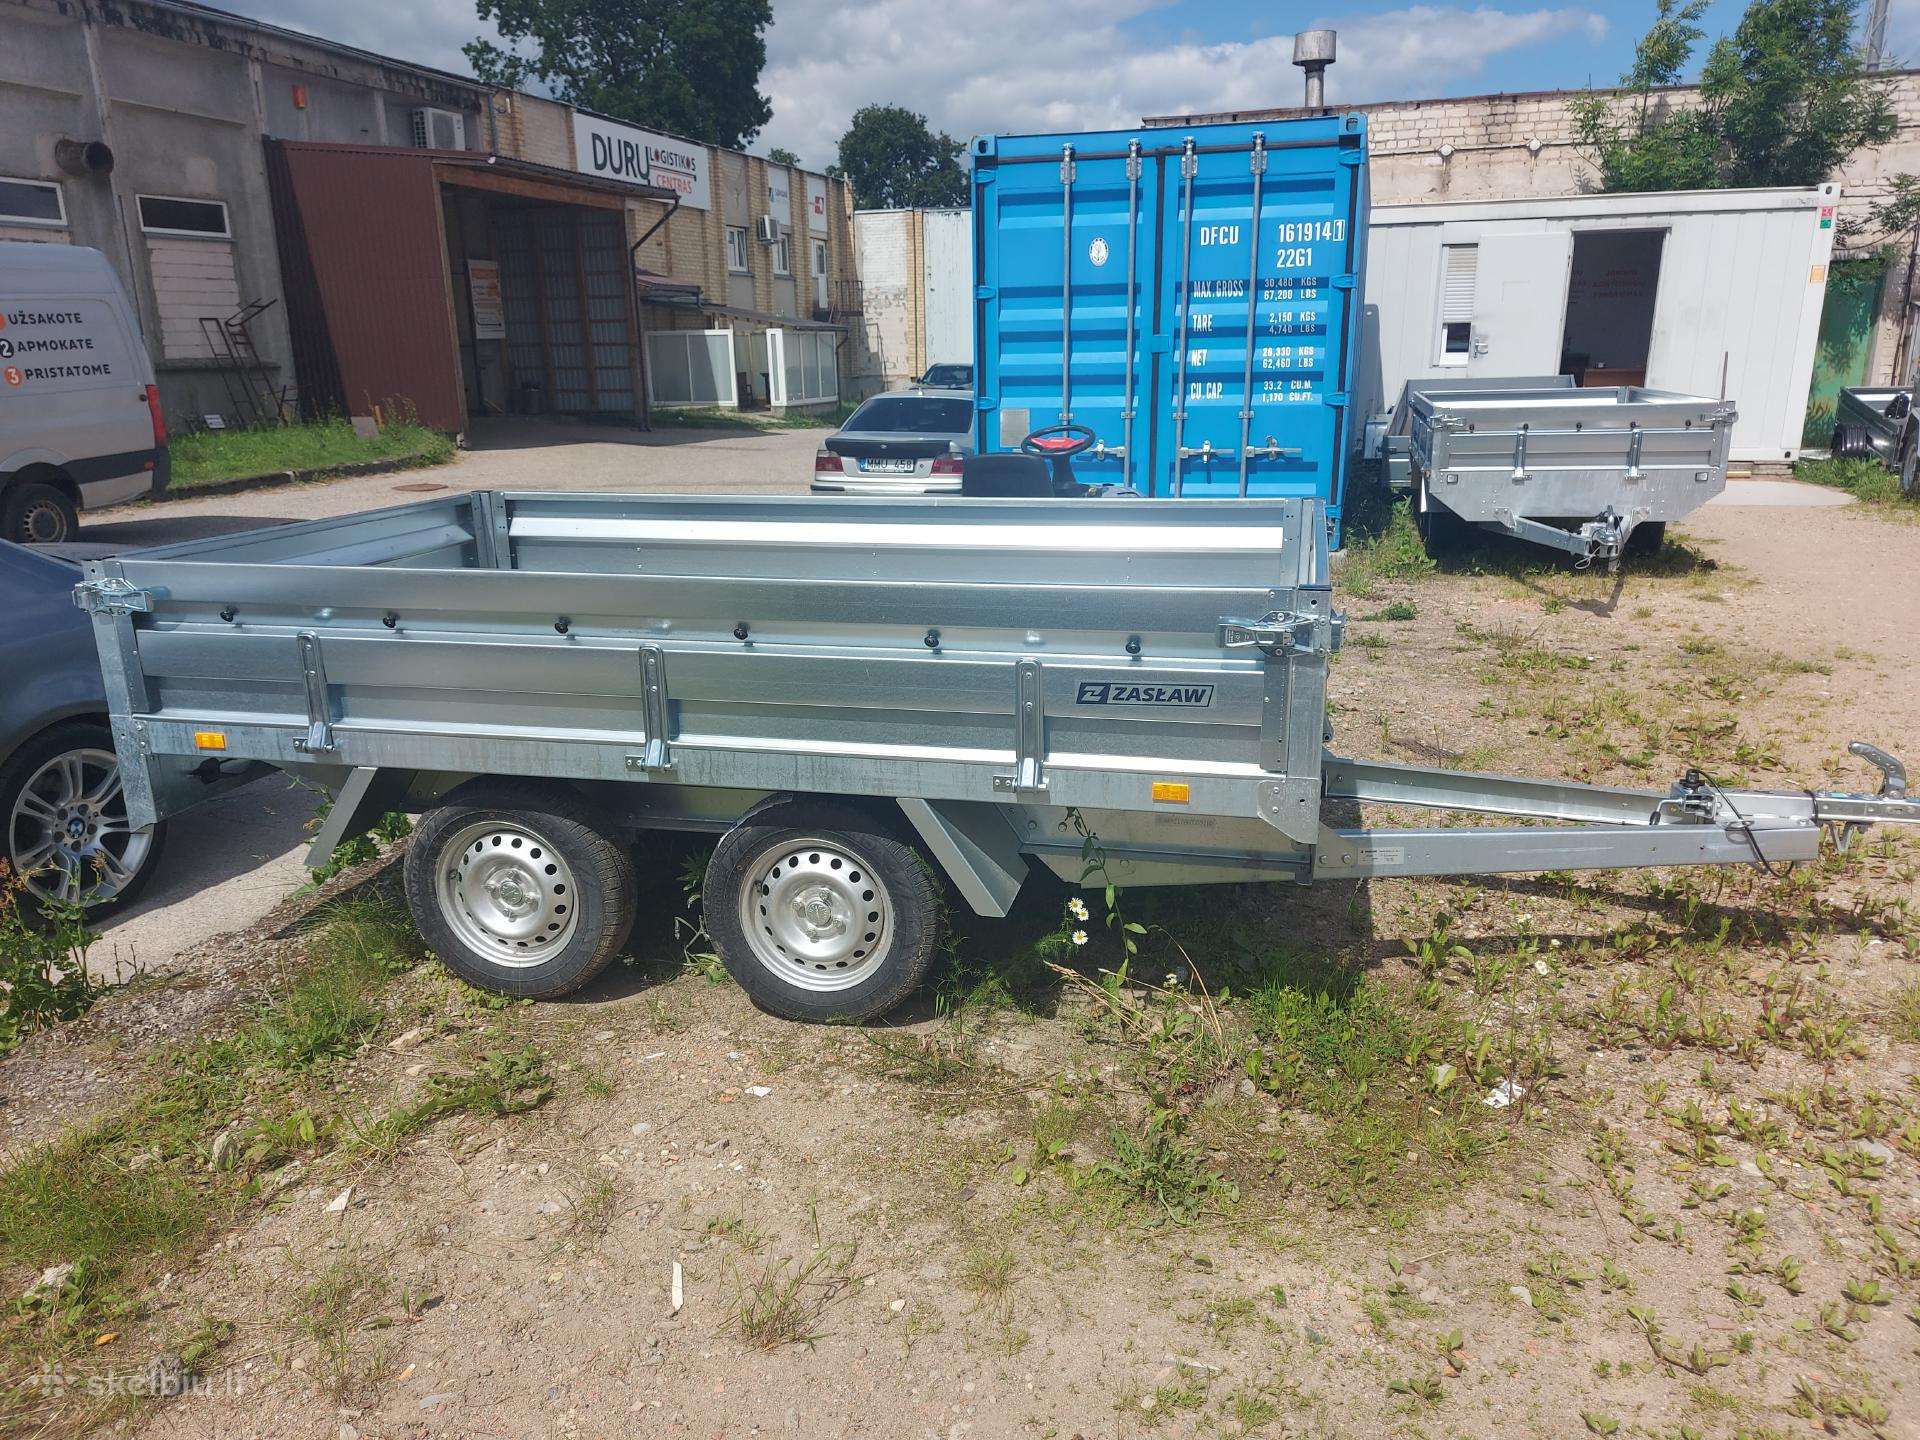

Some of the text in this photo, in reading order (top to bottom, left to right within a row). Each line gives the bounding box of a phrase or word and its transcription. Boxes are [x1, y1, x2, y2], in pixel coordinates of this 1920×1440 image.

[649, 146, 696, 171] LOGISTIKOS
[656, 174, 692, 194] CENTRAS
[1200, 225, 1239, 246] DFCU
[1276, 247, 1312, 268] 22G1
[1301, 276, 1317, 287] KGS
[1264, 288, 1317, 301] 67,200 LBS
[8, 310, 83, 326] UŽSAKOTE
[1192, 313, 1213, 332] TARE
[1269, 310, 1316, 323] 2,150 KGS
[1299, 323, 1316, 333] LBS
[17, 338, 94, 353] APMOKATE
[1298, 346, 1315, 356] KGS
[1191, 348, 1208, 367] NET
[1298, 357, 1314, 368] LBS
[7, 363, 112, 385] 3 PRISTATOME
[1190, 382, 1223, 400] CU.CAP.
[1263, 381, 1282, 391] 33.2
[866, 457, 912, 470] MMU 458
[1112, 687, 1207, 703] ZASŁAW
